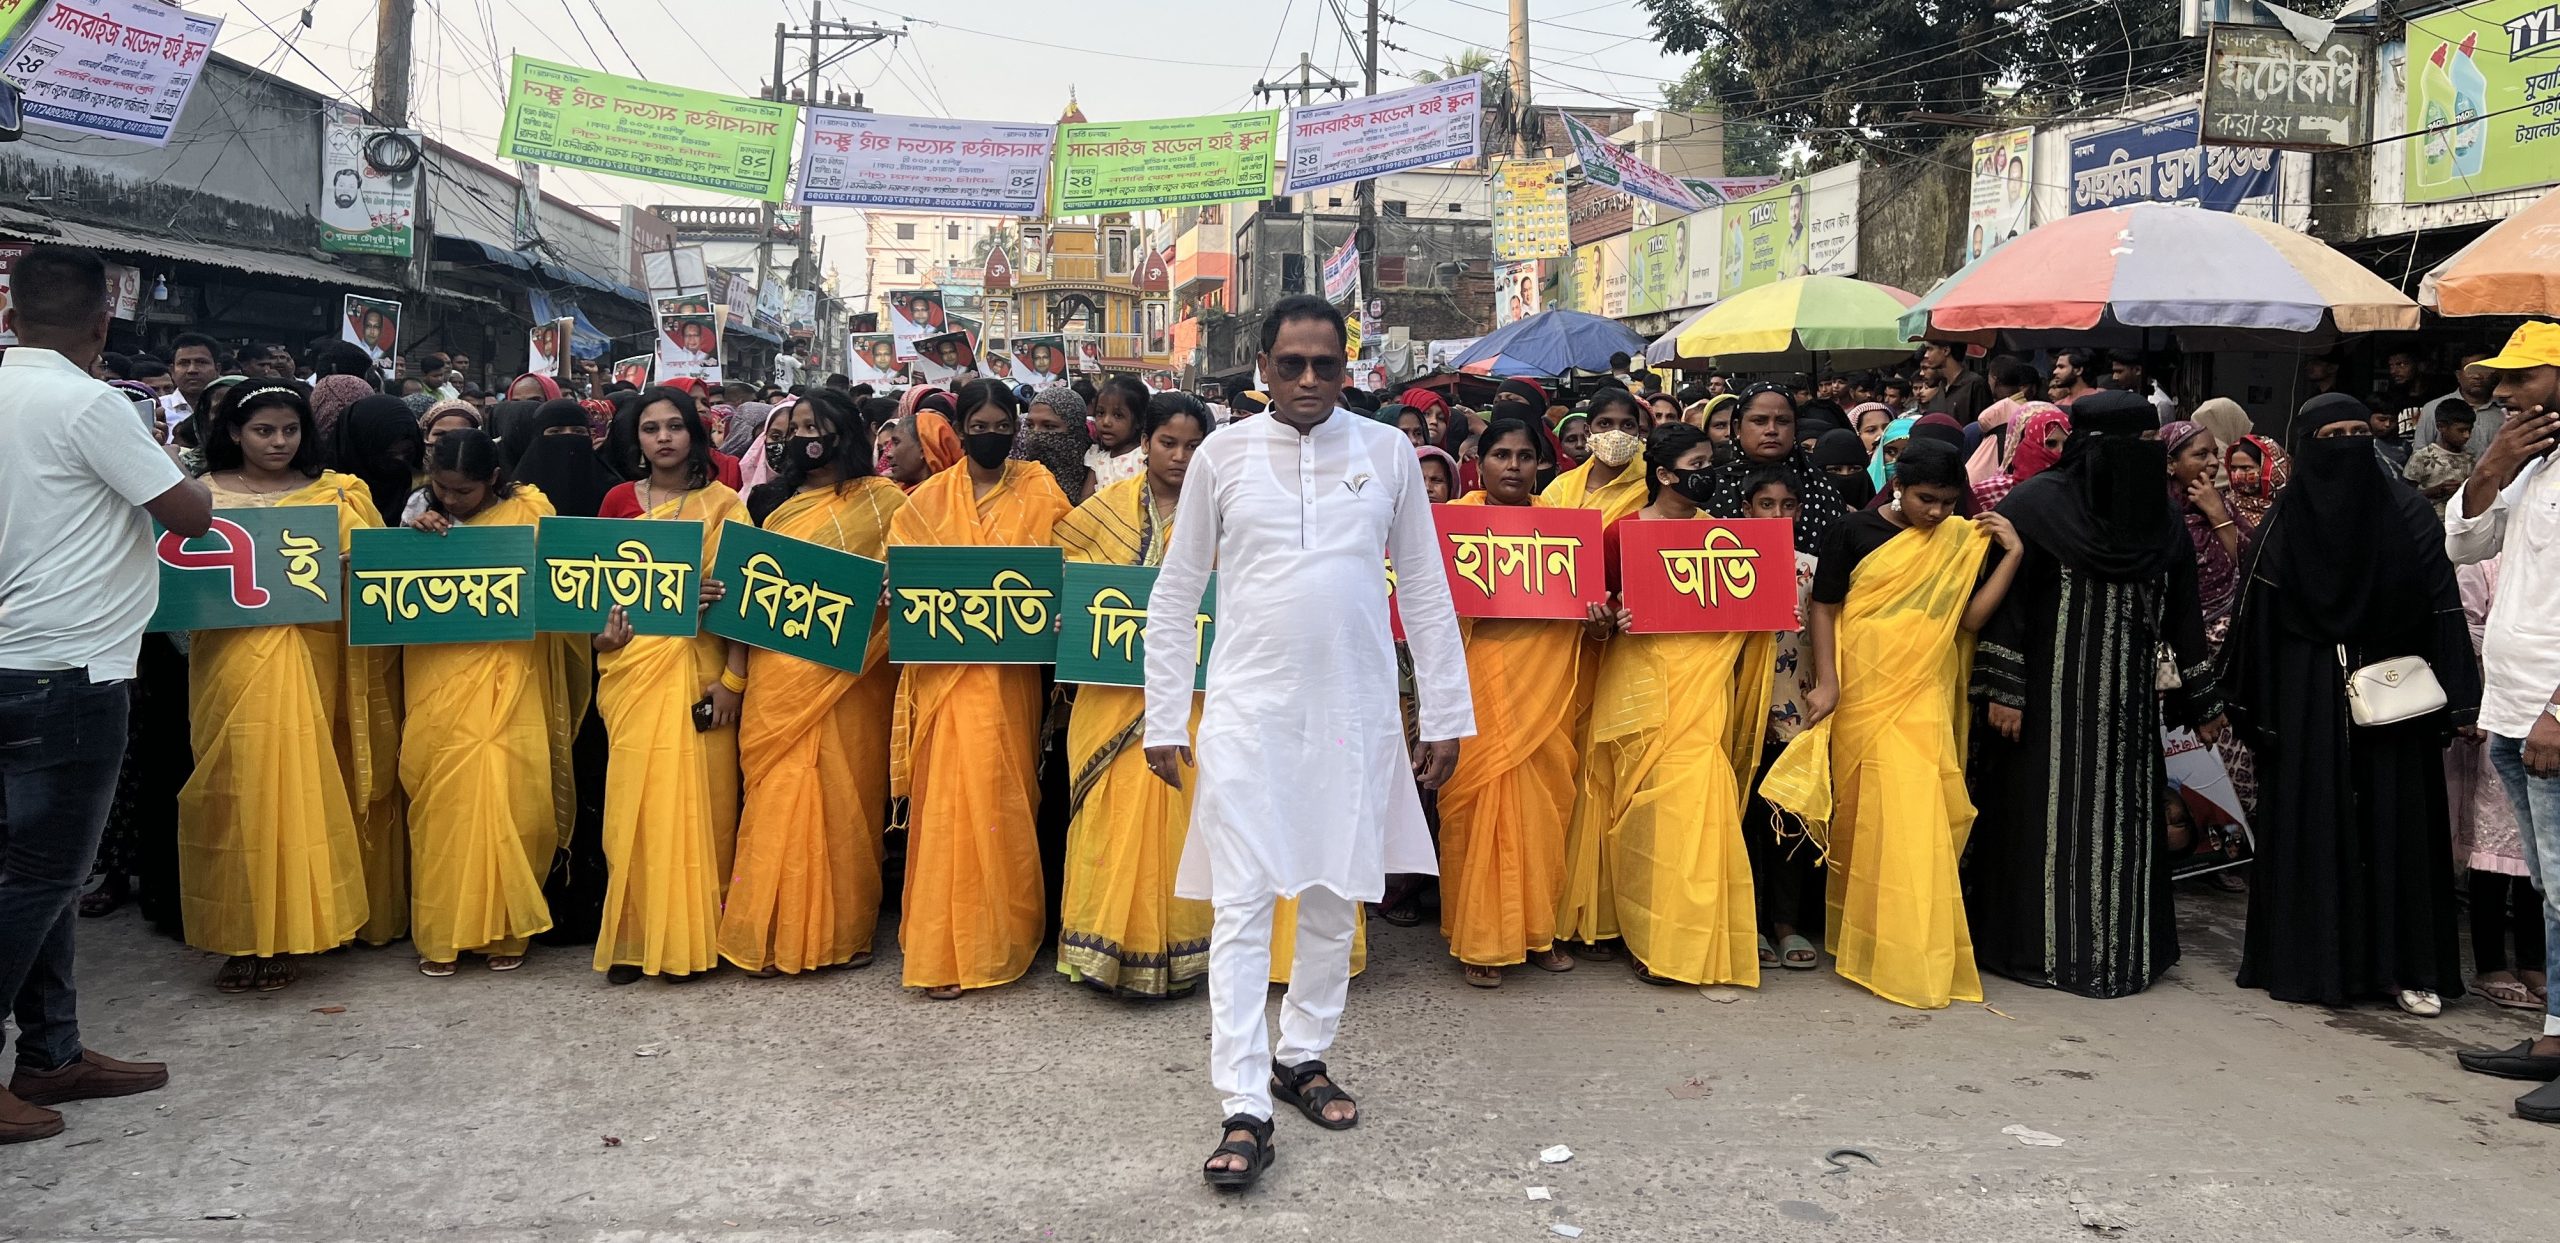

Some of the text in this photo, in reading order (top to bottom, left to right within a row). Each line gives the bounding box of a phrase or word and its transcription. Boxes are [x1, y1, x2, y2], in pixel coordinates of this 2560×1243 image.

[16, 54, 44, 73] ২৪
[48, 2, 122, 46] সানরাইজ
[120, 26, 162, 54] মডেল
[162, 33, 183, 61] হাই
[179, 41, 206, 67] স্কুল
[2219, 44, 2359, 105] ফটোকপি
[1067, 130, 1269, 157] সানরাইজ মডেল হাই স্কুল
[1296, 113, 1365, 136] সানরাইজ
[1368, 103, 1414, 125] মডেল
[1418, 95, 1442, 115] হাই
[1446, 92, 1473, 112] স্কুল
[2215, 108, 2293, 141] করা হয়
[1069, 175, 1091, 187] ২৪
[1298, 152, 1318, 166] ২৪
[2075, 145, 2271, 207] তাহমিনা ড্রাগ হাউজ
[1749, 201, 1778, 228] TYLOX
[156, 516, 329, 609] ৭ ই
[545, 540, 693, 615] জাতীয়
[1447, 527, 1583, 598] হাসান
[1658, 526, 1762, 609] অভি
[353, 566, 527, 624] নভেম্বর
[739, 551, 855, 648] বিপ্লব
[896, 568, 1054, 645] সংহতি
